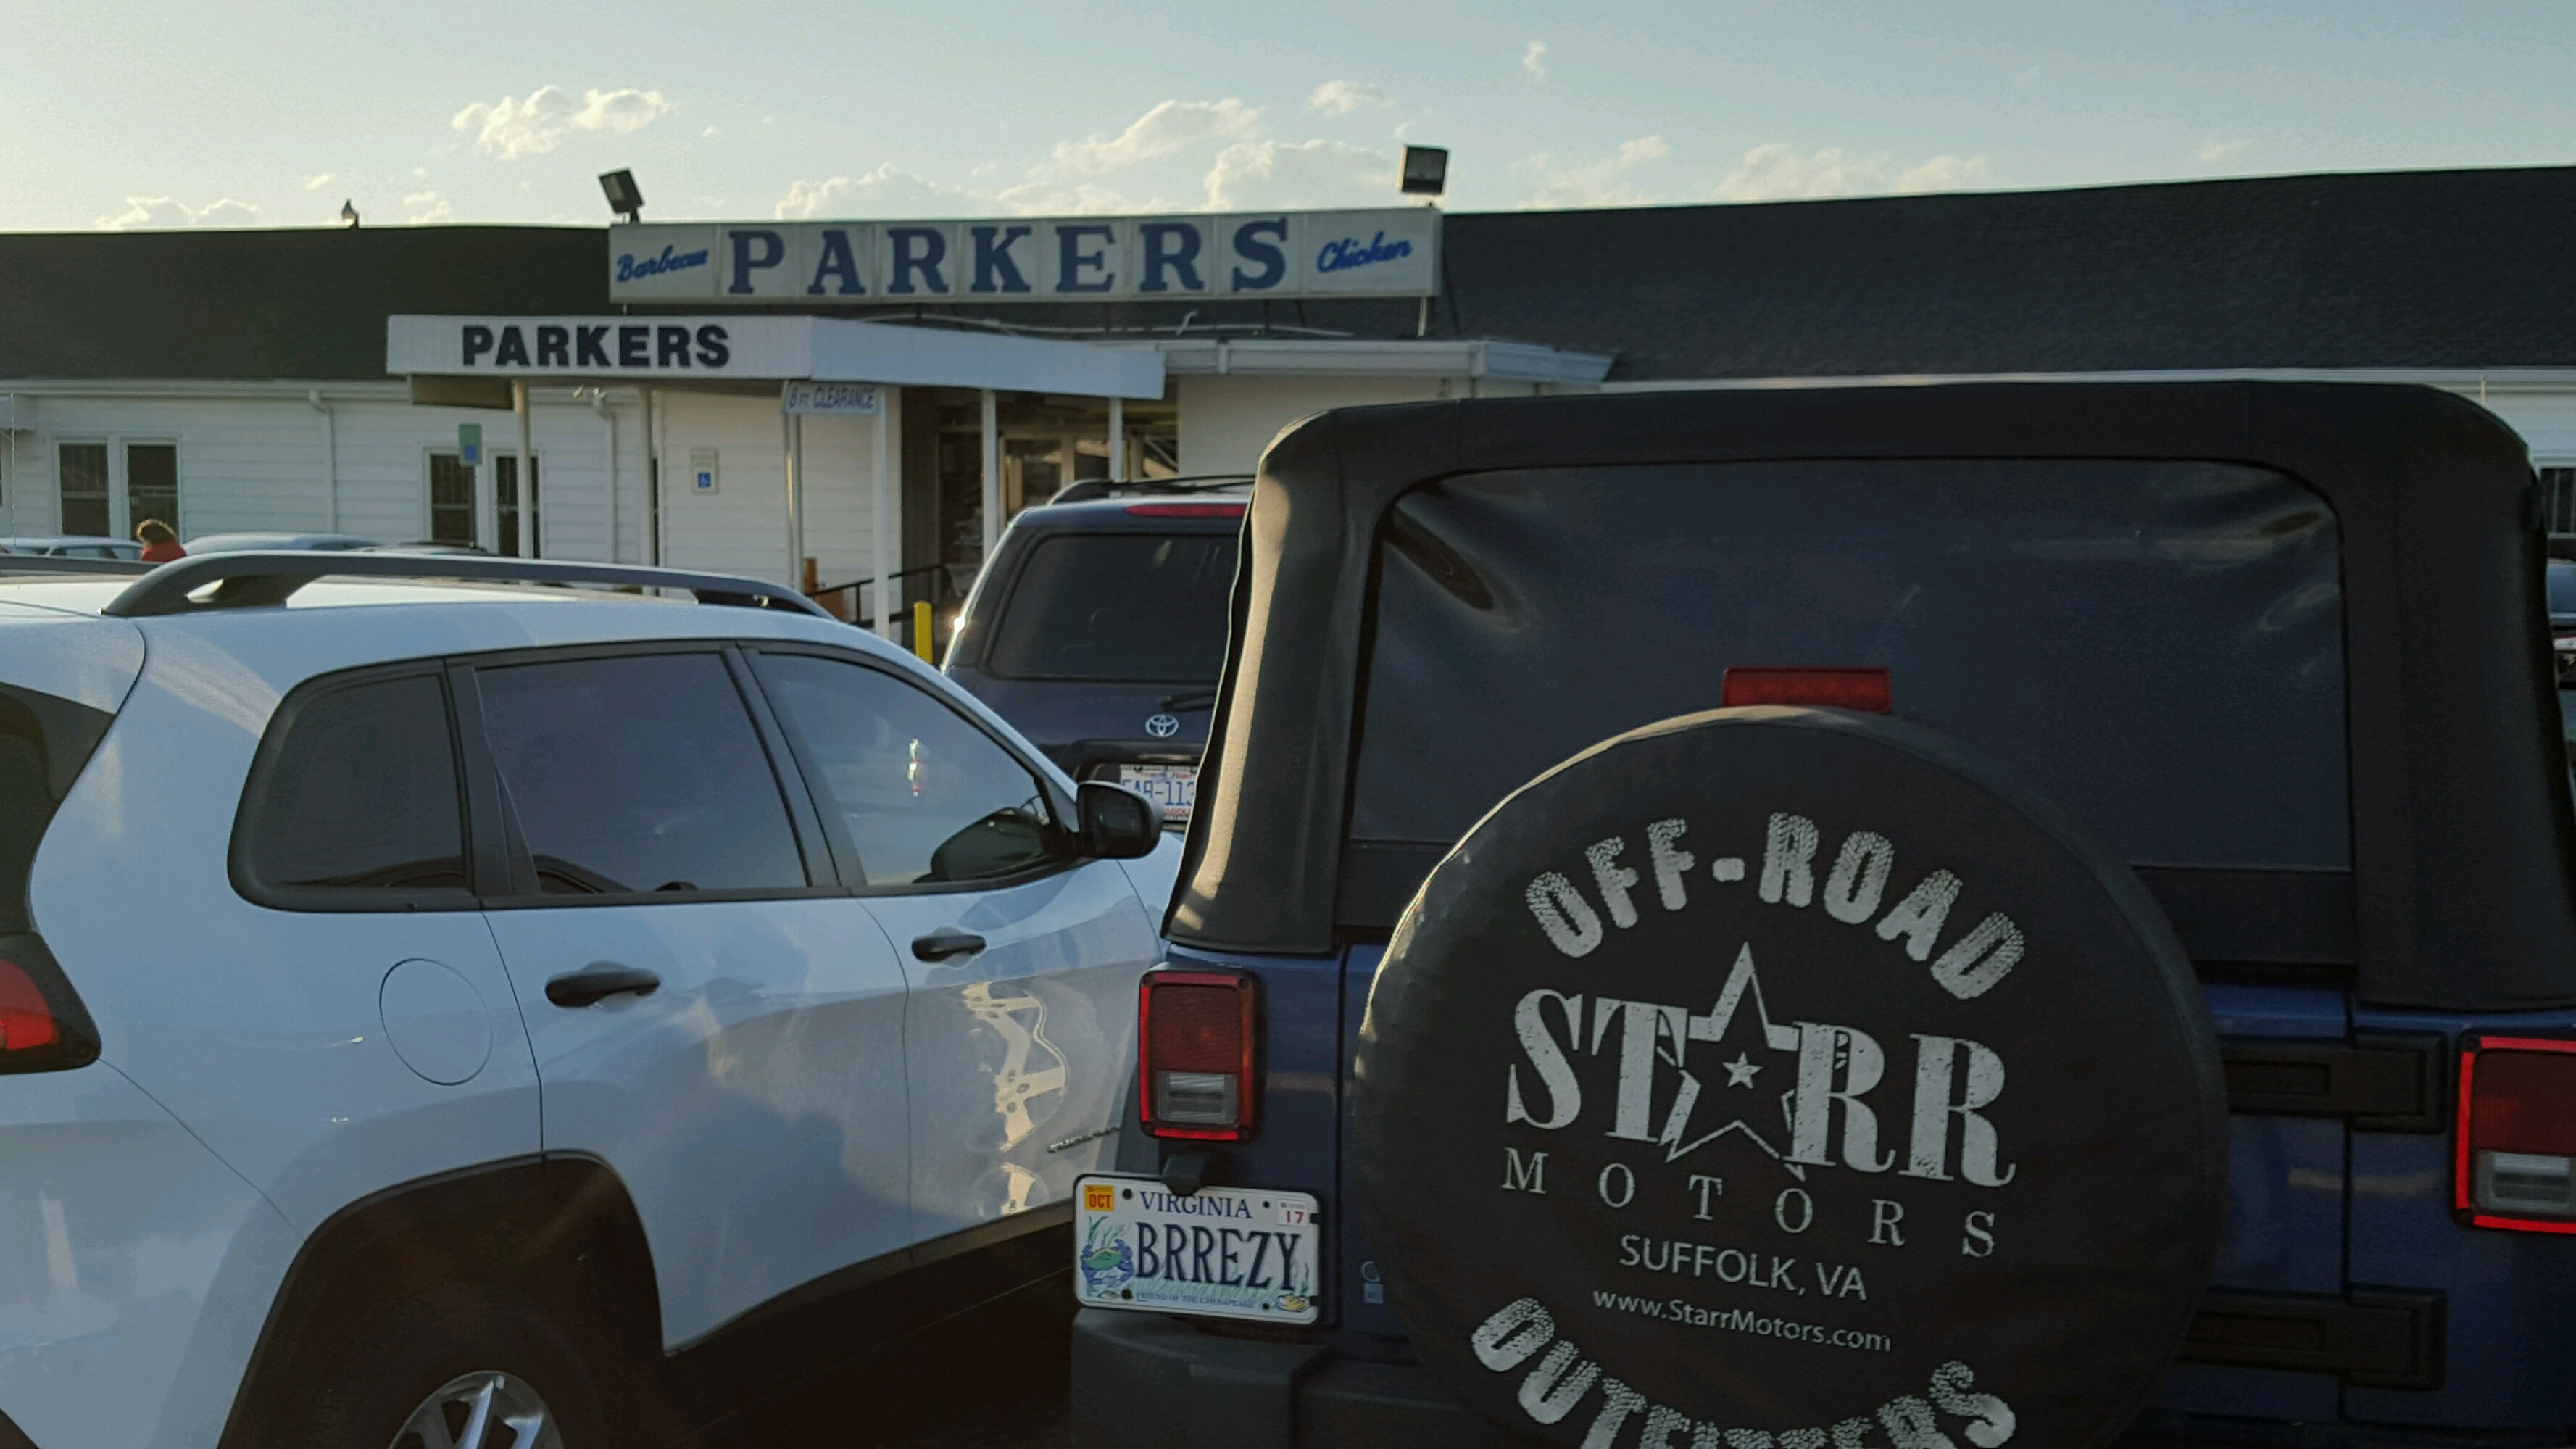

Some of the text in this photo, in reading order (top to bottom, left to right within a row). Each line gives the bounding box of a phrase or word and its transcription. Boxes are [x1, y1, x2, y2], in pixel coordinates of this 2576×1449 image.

[727, 218, 1290, 296] PARKERS
[1317, 230, 1413, 273] Chicken
[462, 325, 729, 368] PARKERS
[1525, 812, 2027, 1000] OFF-ROAD
[1089, 1194, 1111, 1208] OCT
[1139, 1191, 1253, 1219] VIRGINIA
[1287, 1210, 1305, 1224] 17
[1500, 1147, 1997, 1258] MOTORS
[1136, 1222, 1302, 1290] BRREZY
[1619, 1234, 1868, 1301] SUFFOLK, VA
[1593, 1290, 1891, 1353] www.StarrMotors.com
[1471, 1298, 2016, 1449] OUTRS
